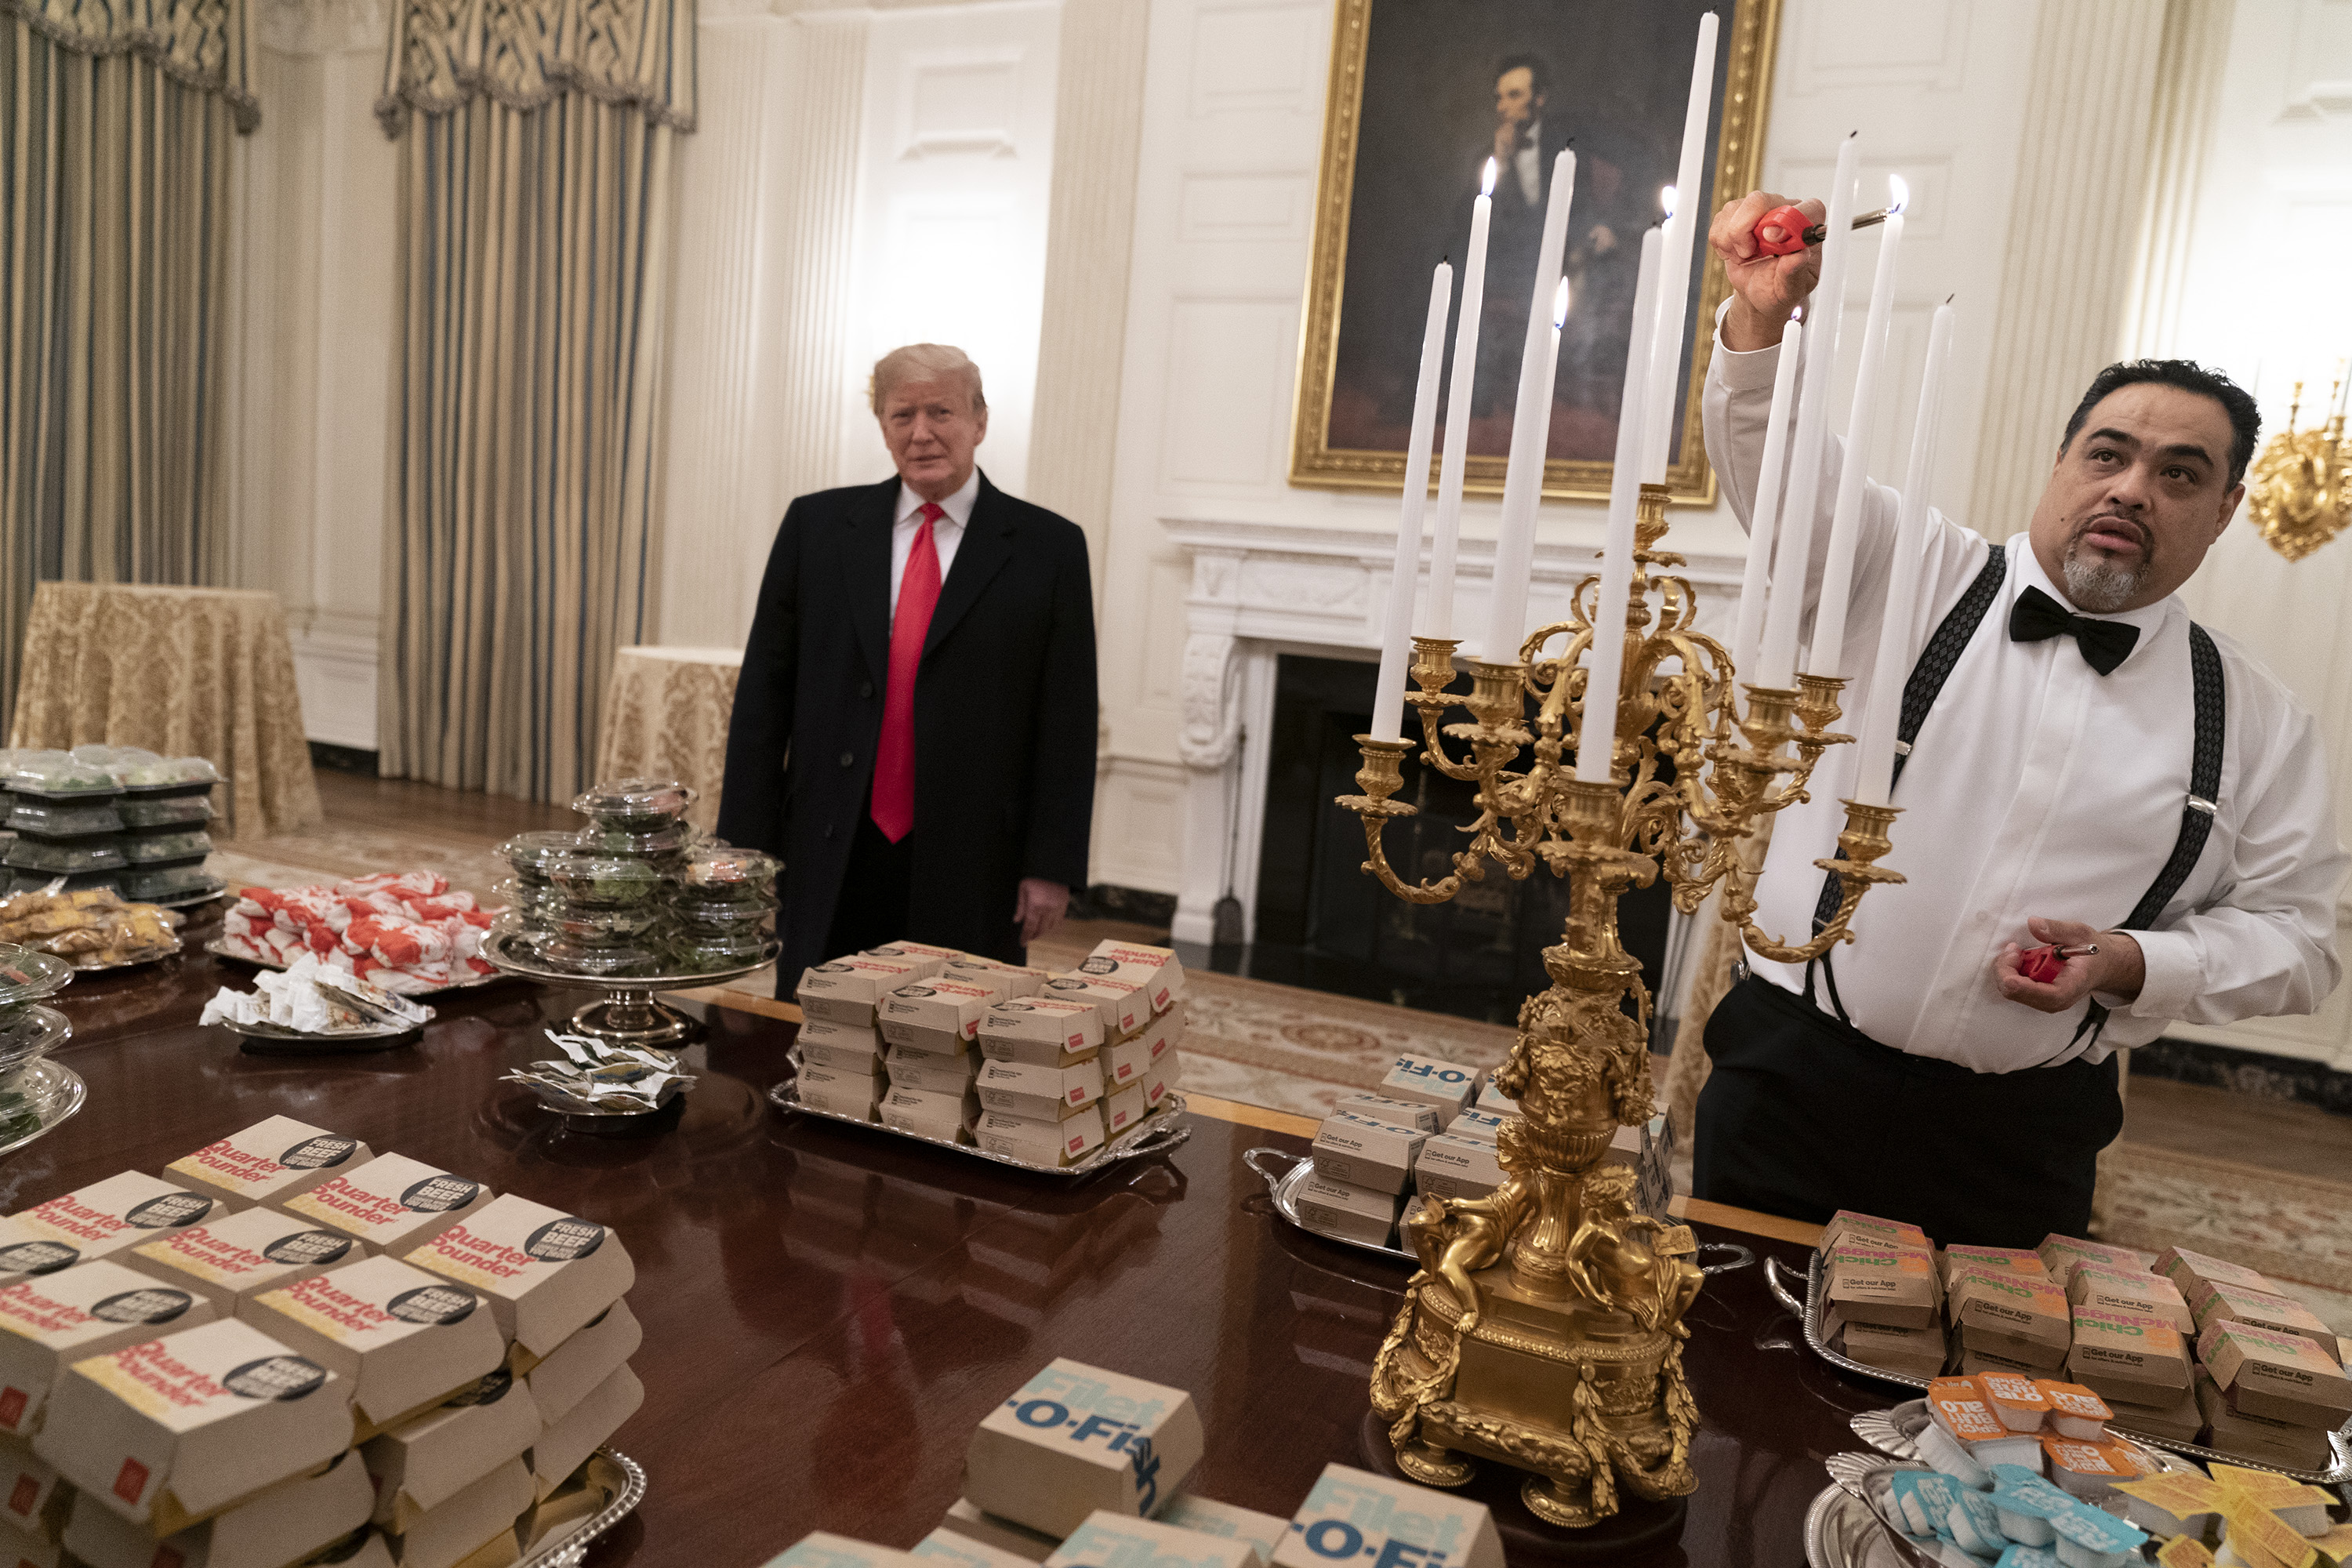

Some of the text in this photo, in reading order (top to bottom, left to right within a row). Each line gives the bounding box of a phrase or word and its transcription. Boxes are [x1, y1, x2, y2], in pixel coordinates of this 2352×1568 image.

[296, 1145, 342, 1158] BEEF
[309, 1138, 352, 1150] FRESH
[188, 1148, 270, 1182] Pounder
[207, 1139, 287, 1174] Quarter
[416, 1185, 465, 1201] BEEF
[428, 1178, 474, 1193] FRESH
[310, 1185, 394, 1225] Pounder
[323, 1177, 411, 1215] Quarter
[48, 1194, 132, 1232] Quarter
[551, 1221, 601, 1238] FRESH
[181, 1227, 272, 1266] Quarter
[441, 1225, 537, 1266] Quarter
[540, 1231, 590, 1247] BEEF
[1856, 1235, 1869, 1243] Get
[424, 1236, 521, 1278] Pounder
[303, 1276, 395, 1323] Quarter
[2136, 1301, 2154, 1310] App
[1984, 1303, 1998, 1312] Get
[2015, 1310, 2032, 1321] App
[2251, 1320, 2266, 1329] Get
[2125, 1353, 2143, 1363] App
[2261, 1365, 2277, 1374] Get
[2296, 1371, 2313, 1382] App
[1023, 1367, 1166, 1428] Filet
[1303, 1475, 1466, 1554] Filet
